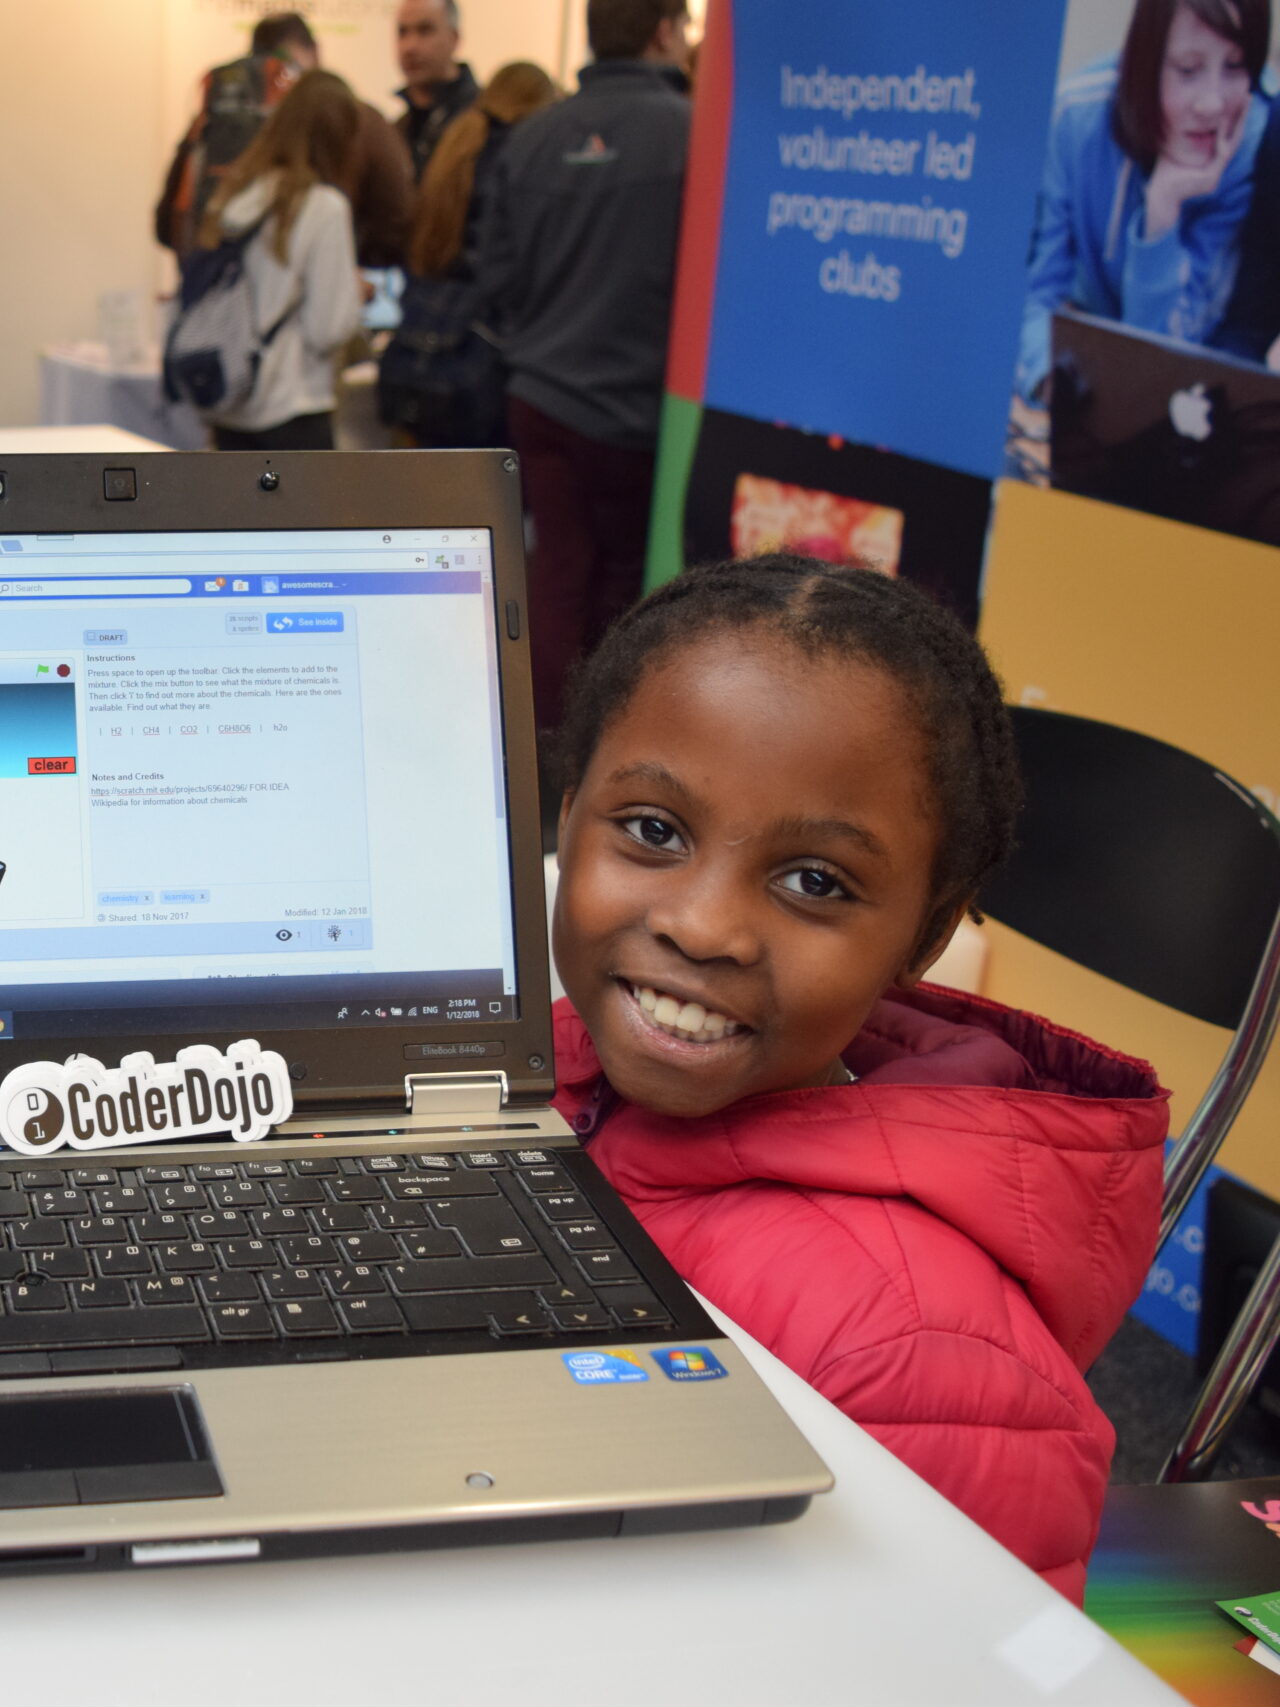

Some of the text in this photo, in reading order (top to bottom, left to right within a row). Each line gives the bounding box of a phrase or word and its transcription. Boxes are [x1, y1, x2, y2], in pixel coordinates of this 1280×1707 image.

[781, 64, 981, 121] Independent,
[778, 126, 976, 180] volunteer led
[767, 192, 967, 258] programming
[819, 250, 901, 302] clubs
[16, 584, 43, 592] Search
[299, 618, 314, 626] See
[99, 634, 123, 642] DRAFT
[86, 654, 136, 662] Instructions
[87, 664, 338, 678] Press space open the Click the elements add the
[120, 680, 138, 688] Click
[141, 680, 153, 688] the
[155, 680, 168, 688] mix
[170, 679, 193, 687] button
[221, 678, 240, 686] what
[241, 678, 253, 686] the
[255, 677, 282, 686] mixture
[293, 676, 331, 685] chemicals
[89, 687, 342, 701] Then click find out more about the Here are the ones
[127, 702, 196, 712] Find out what they
[34, 759, 68, 771] clear
[91, 772, 164, 782] Notes and Credits
[249, 783, 290, 792] FOR IDEA
[91, 795, 248, 808] Wikipedia for information about chemicals
[101, 892, 195, 903] chemistry learning
[322, 906, 368, 916] 12 Jan 2018
[141, 911, 189, 921] 18 Nov 2017
[464, 999, 476, 1007] PM
[423, 1006, 438, 1014] ENG
[446, 1010, 480, 1019] 1/12/2018
[422, 1045, 486, 1056] EliteBook 8440p
[68, 1061, 275, 1141] CoderDojo
[200, 1215, 214, 1223] O
[262, 1212, 271, 1220] P
[19, 1222, 29, 1231] Y
[81, 1221, 91, 1229] U
[167, 1247, 177, 1255] K
[229, 1245, 236, 1253] L
[43, 1252, 55, 1261] H
[105, 1250, 112, 1259] J
[81, 1283, 95, 1292] N
[147, 1281, 162, 1290] M
[18, 1287, 28, 1296] B
[351, 1300, 367, 1309] ctrl
[222, 1307, 250, 1316] alt gr
[576, 1369, 612, 1379] CORE
